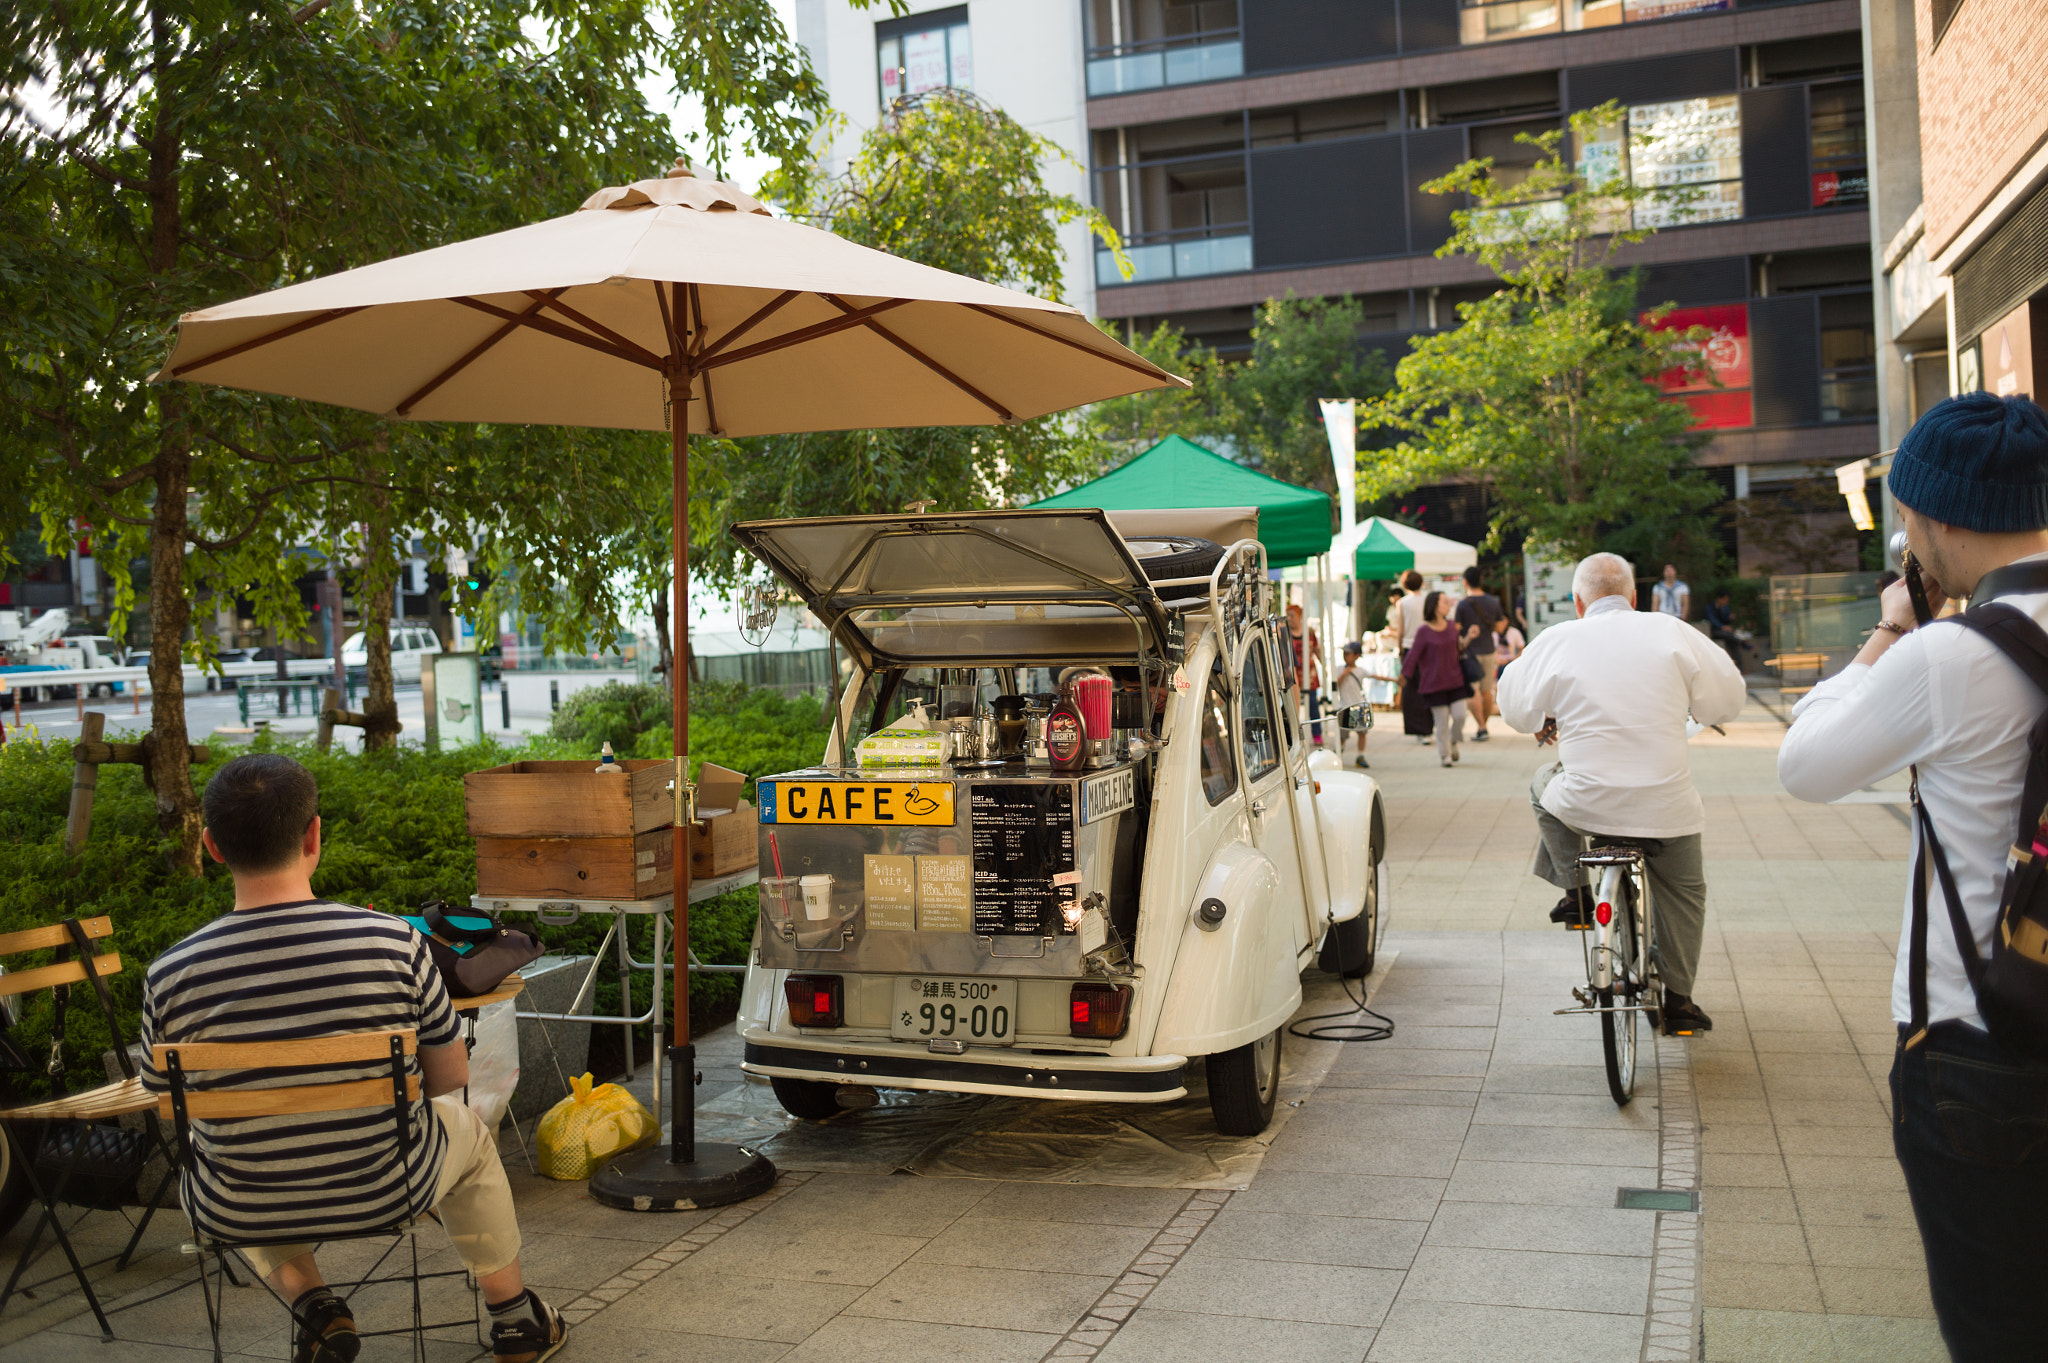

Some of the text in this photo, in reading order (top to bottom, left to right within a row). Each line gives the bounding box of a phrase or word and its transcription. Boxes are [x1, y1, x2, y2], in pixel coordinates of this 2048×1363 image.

[765, 806, 772, 816] F
[787, 786, 895, 821] CAFE
[1088, 773, 1132, 818] MADELEINE
[922, 981, 990, 1000] 練馬 500
[900, 1002, 1009, 1039] な 99-00
